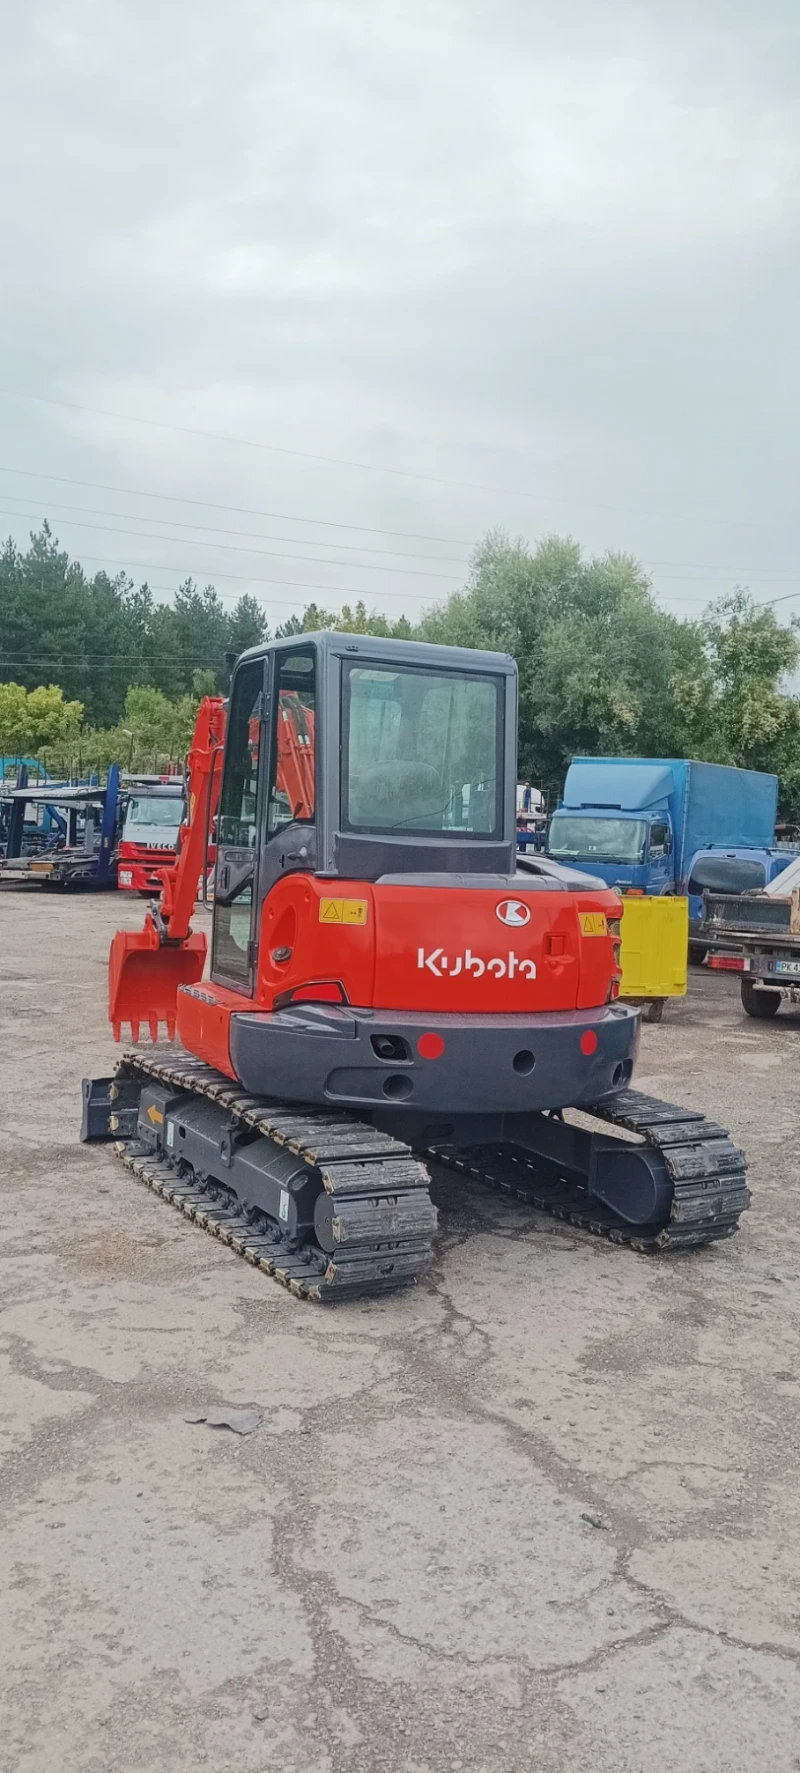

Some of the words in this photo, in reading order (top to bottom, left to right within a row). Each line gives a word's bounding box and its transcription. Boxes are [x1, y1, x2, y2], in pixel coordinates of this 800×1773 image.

[146, 842, 174, 850] IVECO
[417, 947, 537, 980] Kubota
[781, 962, 791, 972] PK
